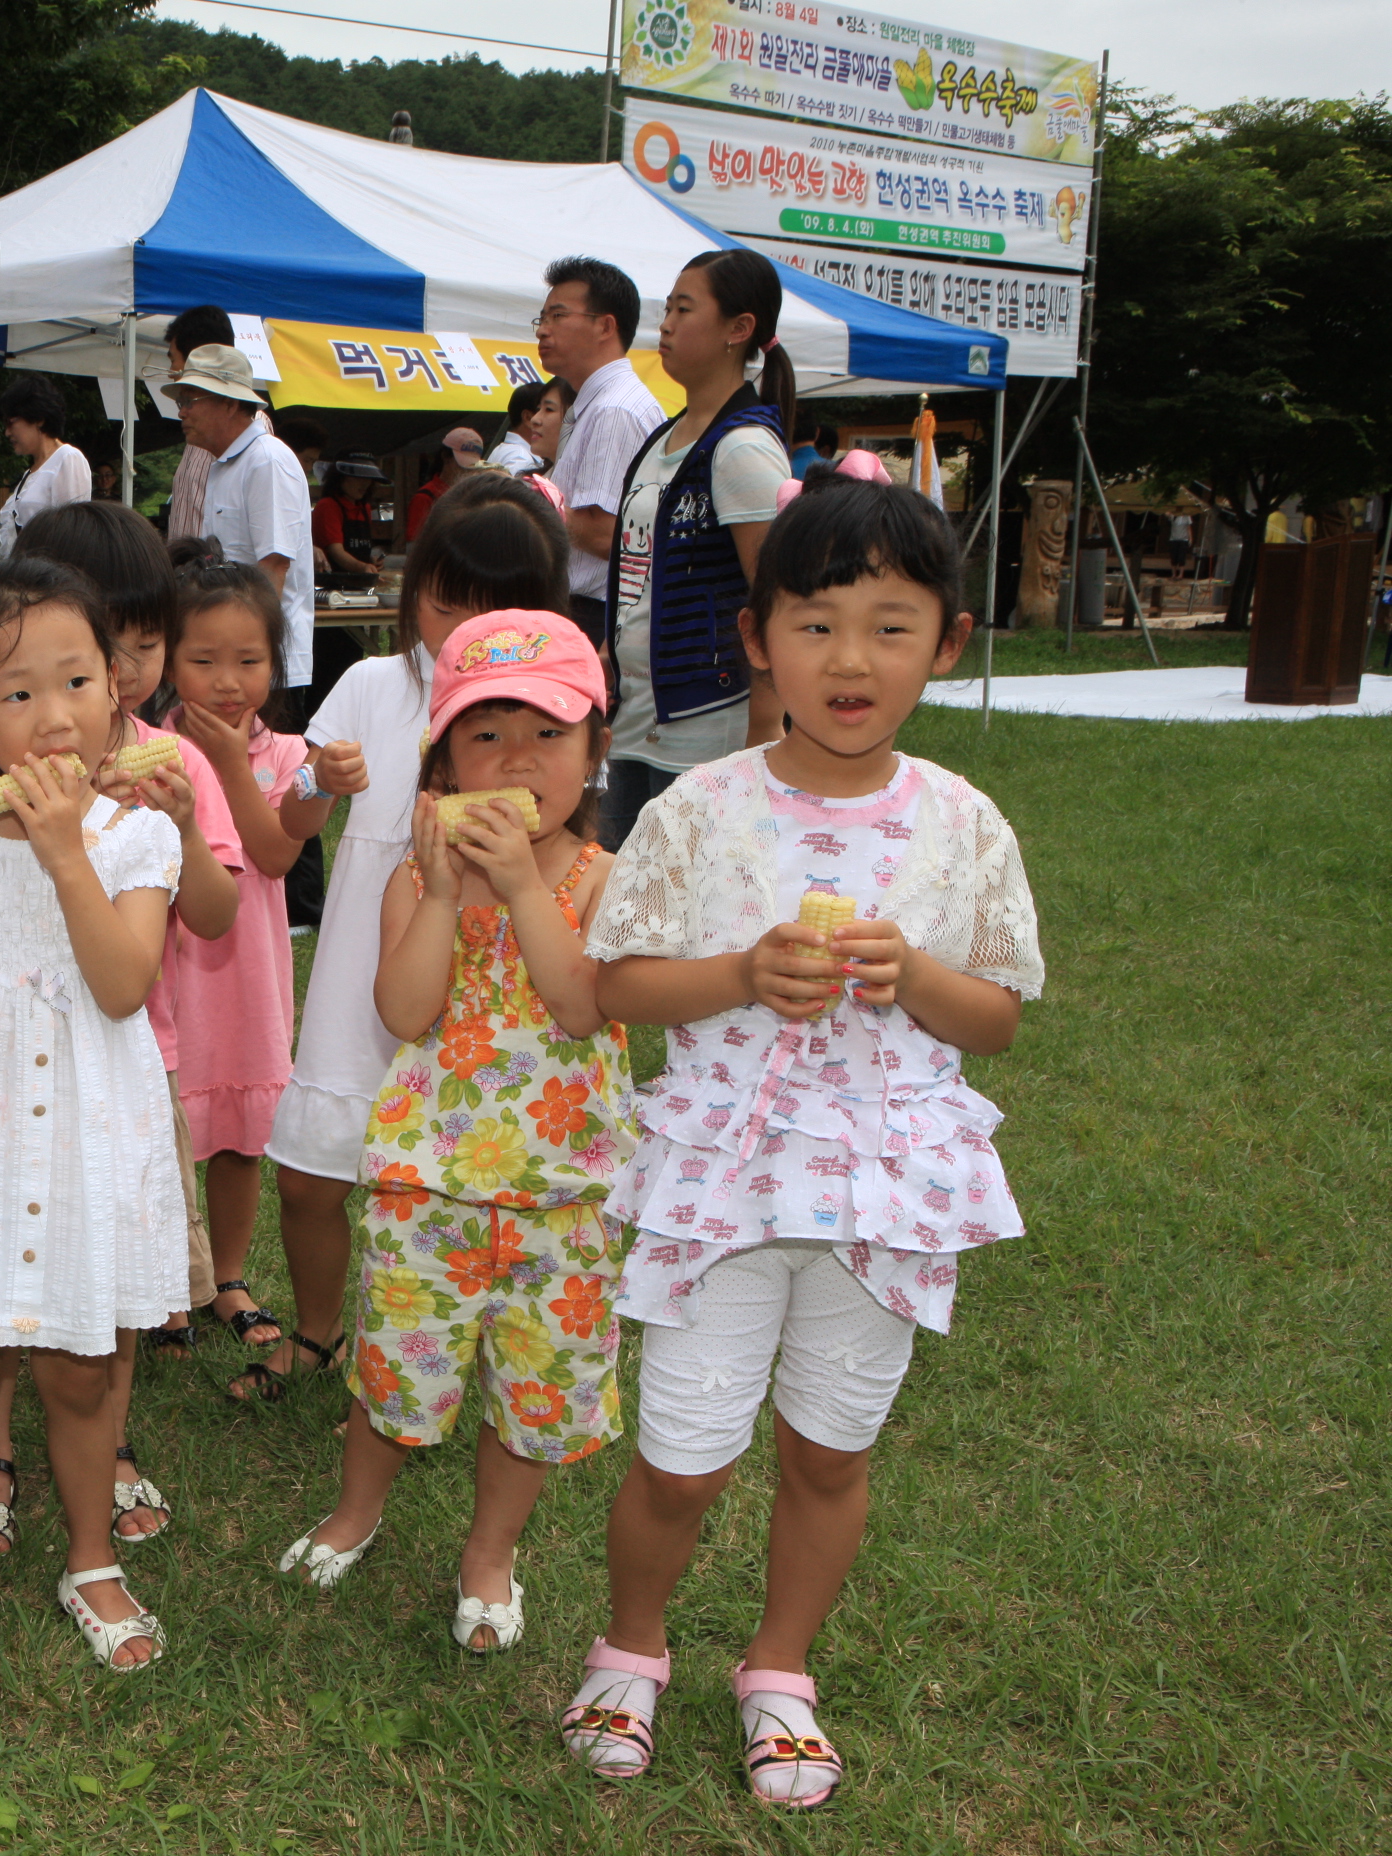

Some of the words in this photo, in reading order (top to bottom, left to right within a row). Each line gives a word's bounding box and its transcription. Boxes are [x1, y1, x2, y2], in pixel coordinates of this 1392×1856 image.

[775, 1, 795, 21] 8월
[798, 7, 818, 26] 4일
[845, 15, 868, 35] 장소
[879, 21, 920, 46] 원일전리
[923, 32, 944, 51] 마을
[946, 37, 976, 58] 체험장
[711, 23, 754, 66] 제1회
[759, 32, 819, 79] 원일전리
[822, 45, 892, 92] 금풀애마을
[937, 60, 1038, 128] 옥수수축제
[729, 83, 761, 101] 옥수수
[764, 91, 785, 109] 따기
[796, 95, 835, 118] 옥수수밥
[838, 104, 857, 122] 짓기
[867, 109, 895, 128] 옥수수
[898, 115, 933, 136] 떡만들기
[809, 136, 835, 151] 2010
[940, 156, 965, 172] 성공적
[708, 139, 753, 184] 삶의
[758, 144, 825, 194] 맛있는
[831, 160, 866, 201] 고향
[876, 168, 950, 214] 현성권역
[957, 180, 1007, 221] 옥수수
[1013, 188, 1045, 227] 축제
[898, 225, 940, 242] 현성권역
[942, 230, 991, 250] 추진위원회
[941, 273, 992, 327] 우리모두
[997, 279, 1019, 329] 힘을
[1024, 282, 1070, 333] 모읍시다
